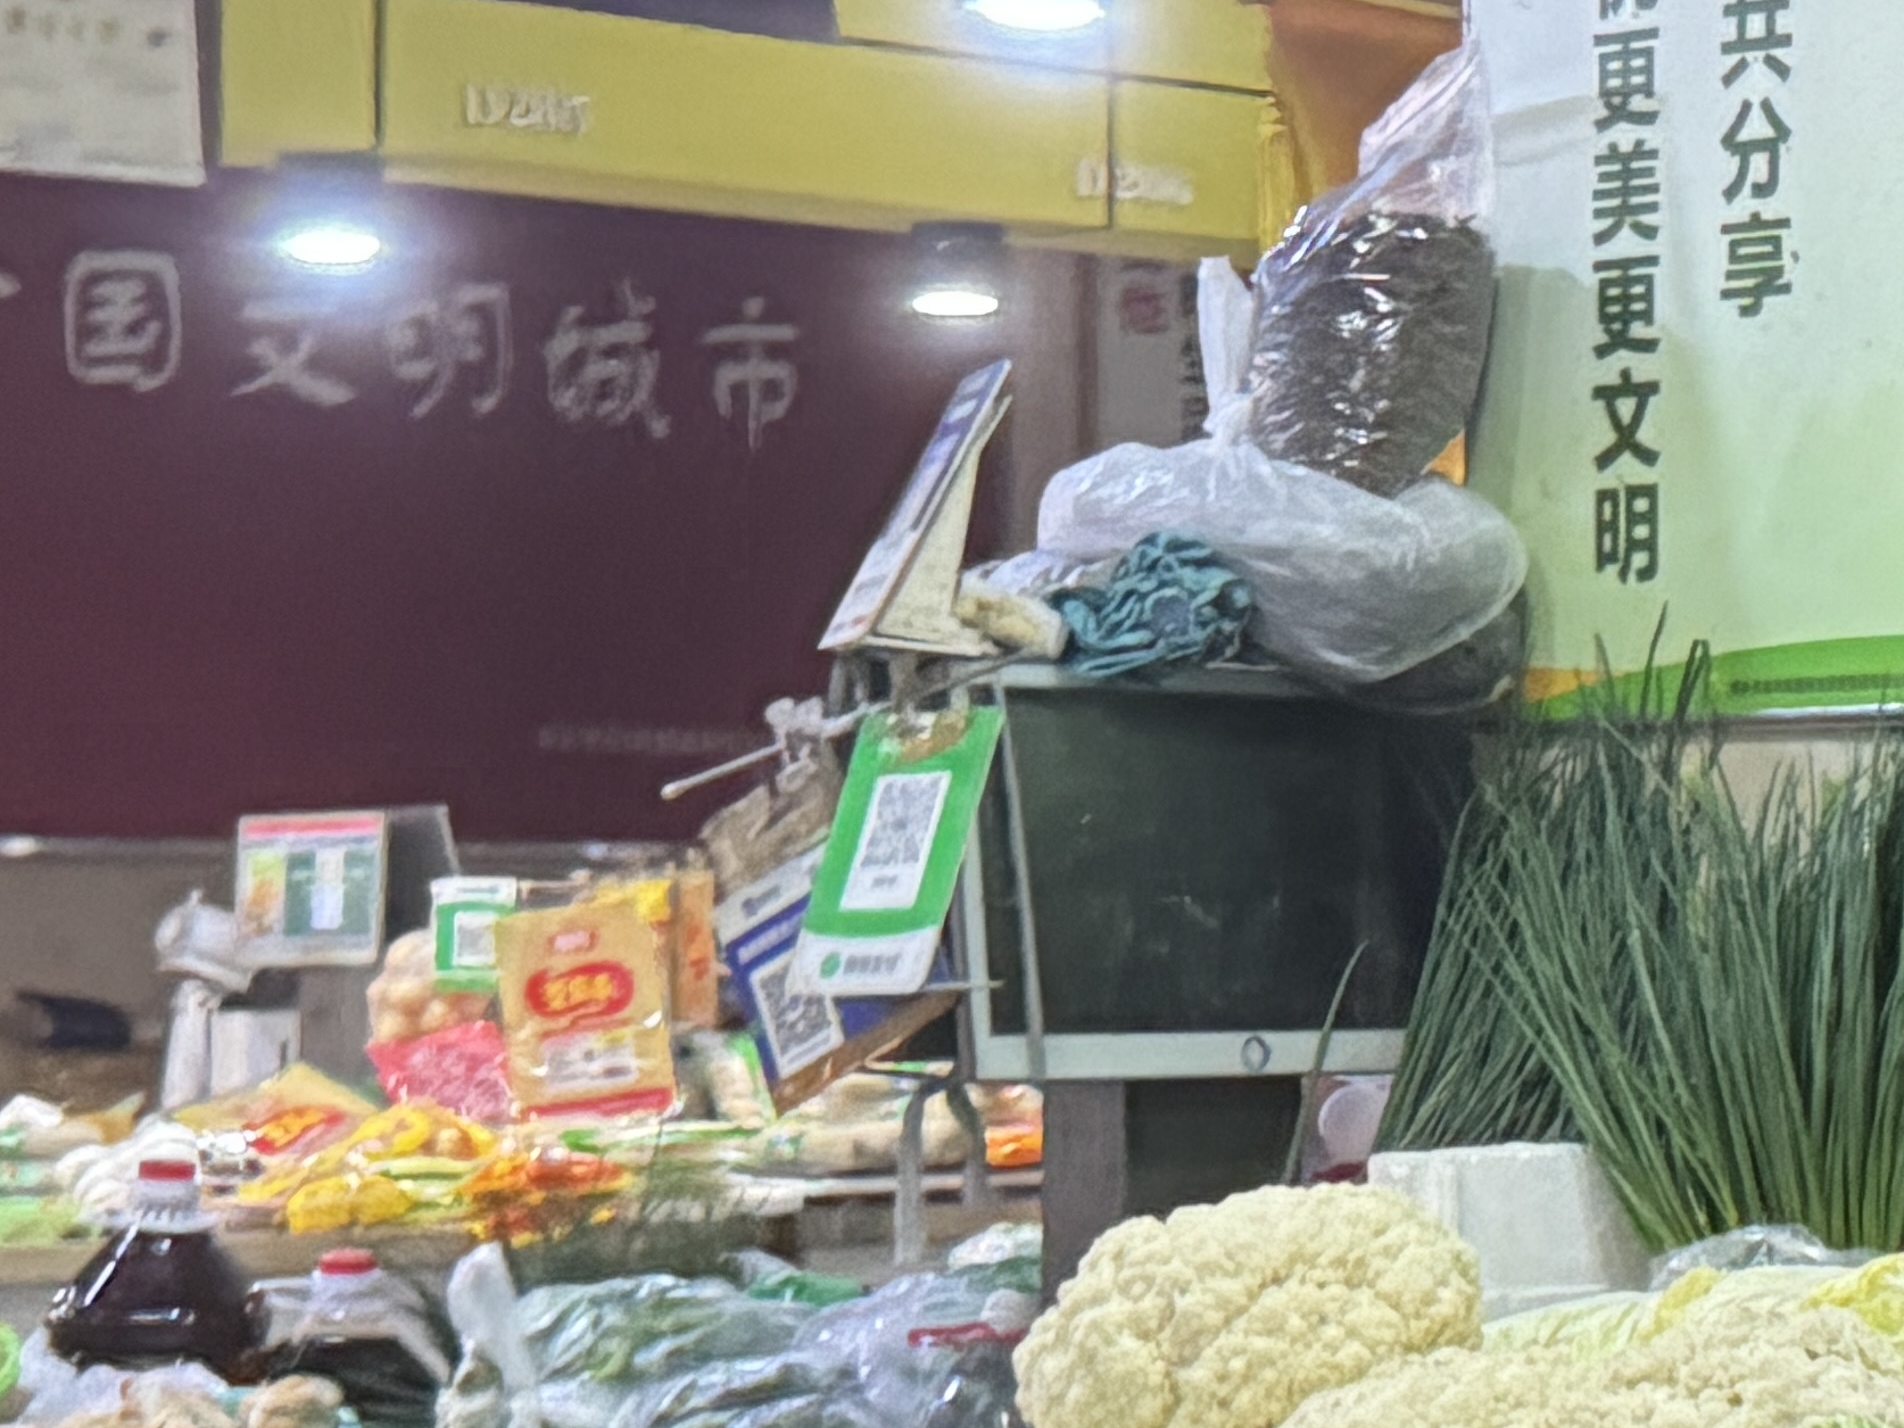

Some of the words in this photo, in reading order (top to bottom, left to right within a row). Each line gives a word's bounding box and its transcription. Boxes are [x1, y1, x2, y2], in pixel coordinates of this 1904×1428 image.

[0, 248, 799, 452] 国文明城市
